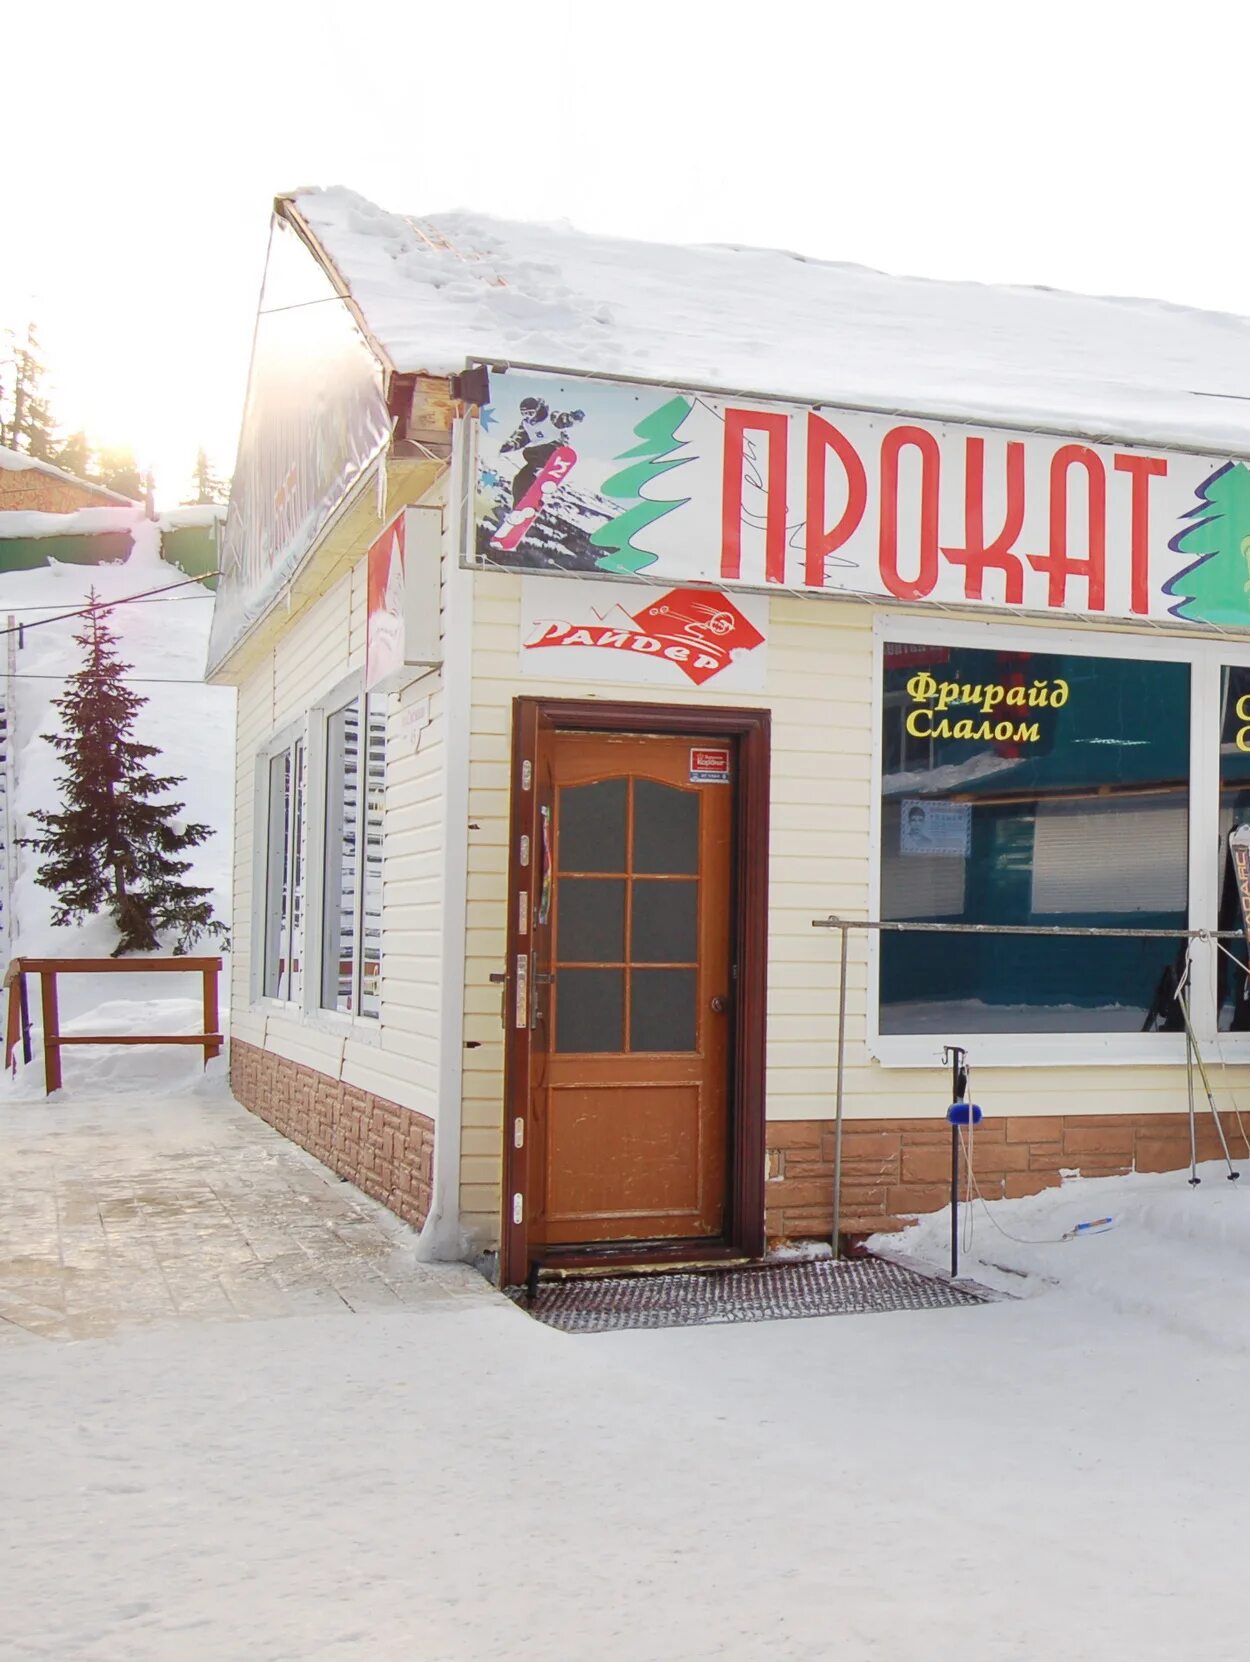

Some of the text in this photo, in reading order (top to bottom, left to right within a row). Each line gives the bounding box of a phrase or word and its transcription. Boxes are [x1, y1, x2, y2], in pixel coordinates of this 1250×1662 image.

[720, 408, 1168, 616] ПРОКАТ
[905, 672, 1070, 713] Фрирайд
[905, 709, 1041, 742] Слалом
